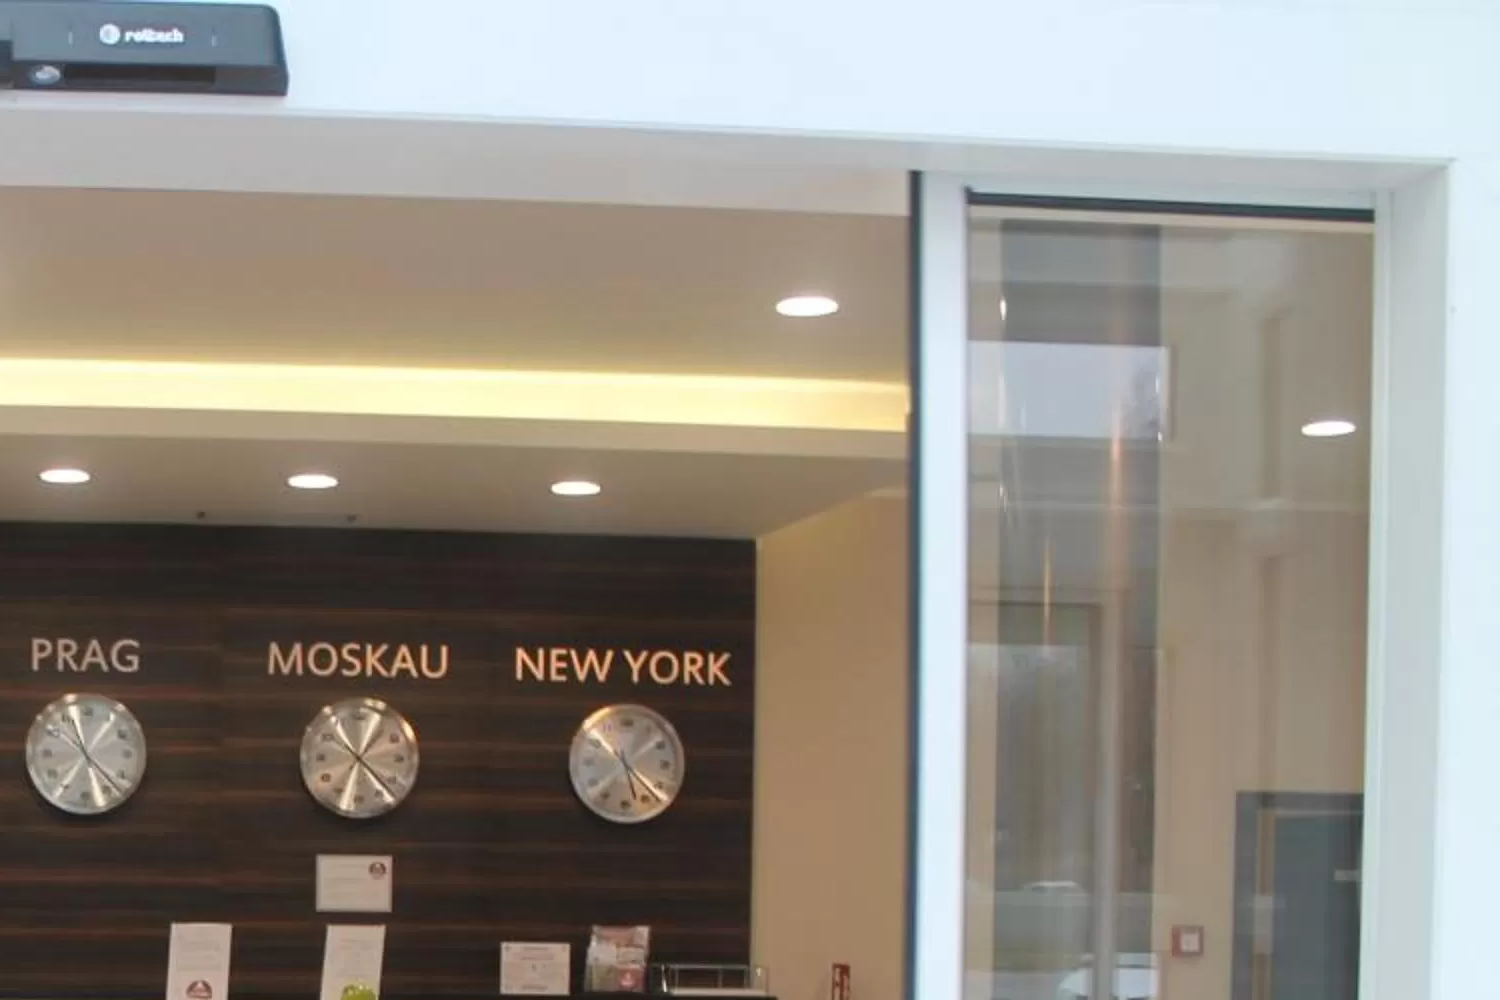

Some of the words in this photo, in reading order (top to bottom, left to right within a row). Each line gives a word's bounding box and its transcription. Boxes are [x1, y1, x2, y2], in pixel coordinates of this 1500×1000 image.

[32, 638, 140, 673] PRAG
[268, 642, 449, 679] MOSKAU
[515, 647, 612, 682] NEW
[623, 650, 731, 686] YORK
